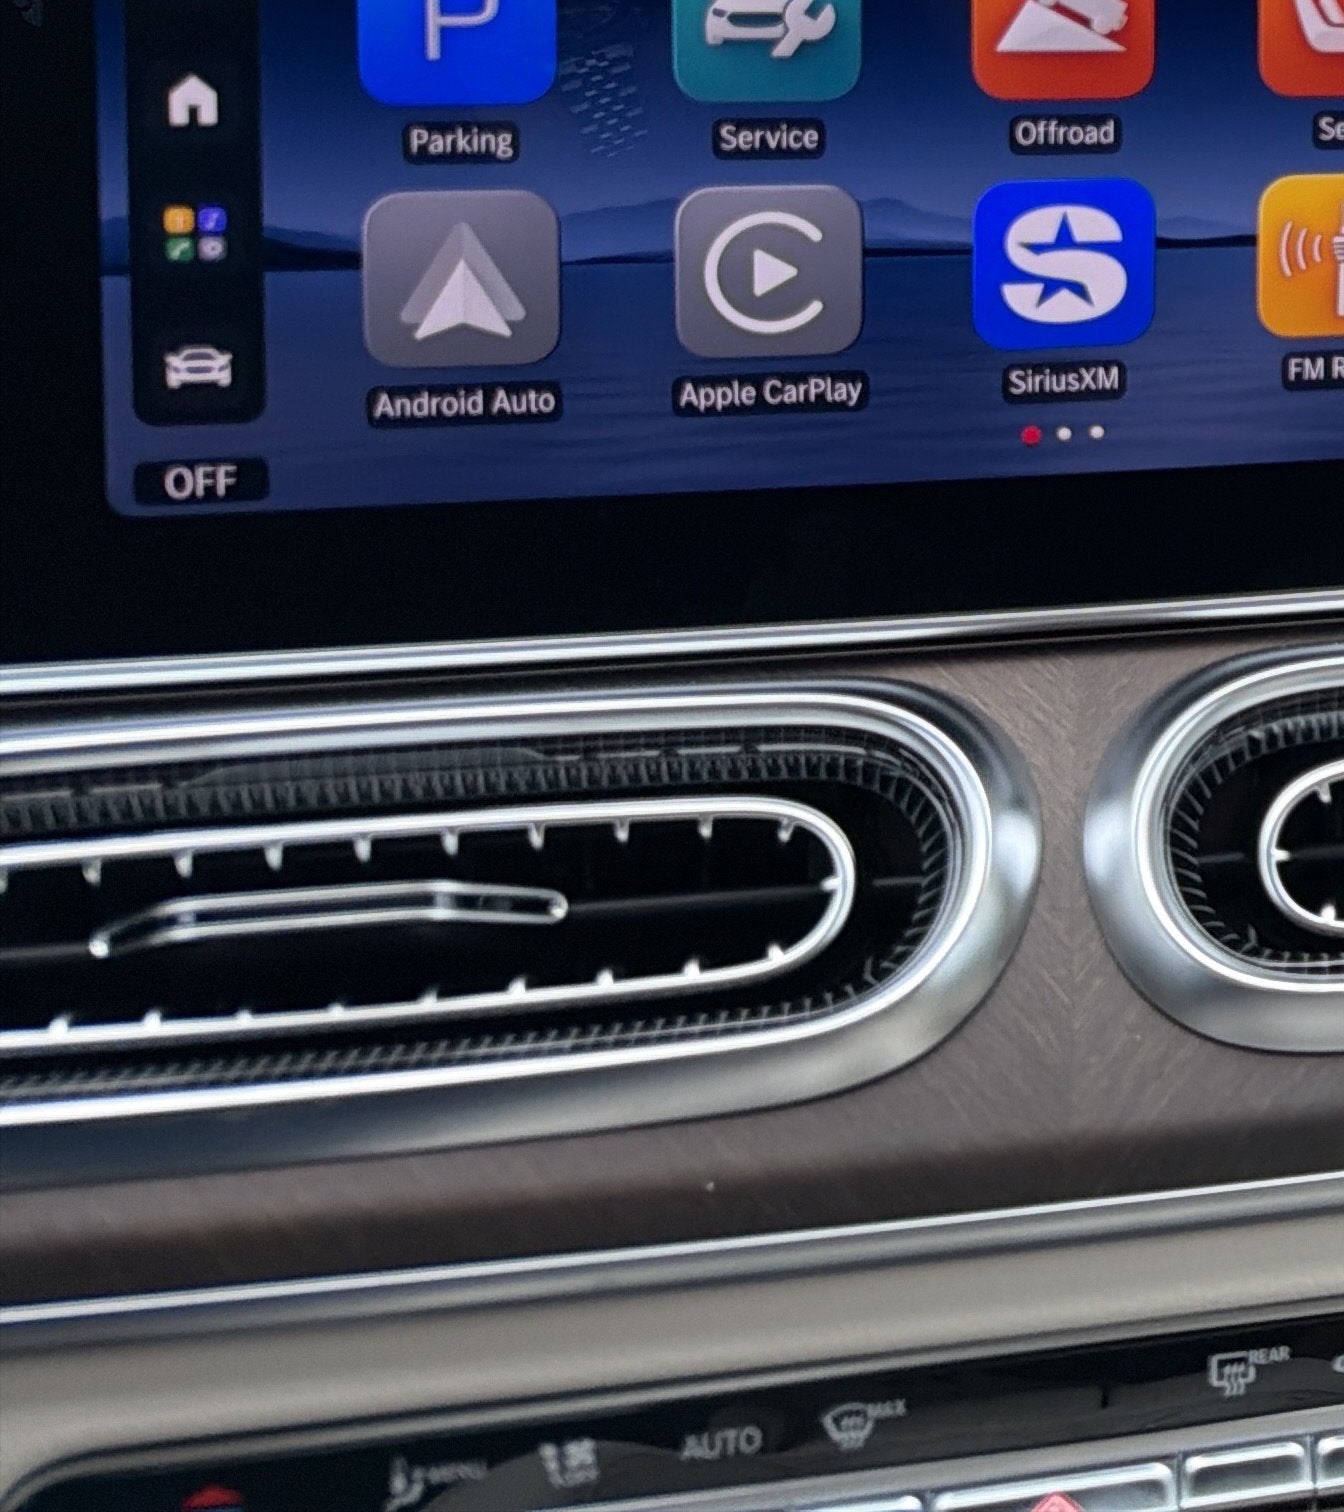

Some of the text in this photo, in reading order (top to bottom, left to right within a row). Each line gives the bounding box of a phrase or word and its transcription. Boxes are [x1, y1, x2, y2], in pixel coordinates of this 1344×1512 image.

[410, 127, 514, 160] Parking
[719, 123, 819, 152] Service
[1015, 117, 1115, 147] Offroad
[1009, 365, 1120, 397] SiriusXM
[1288, 357, 1325, 382] FM
[374, 387, 556, 419] Android Auto
[679, 375, 863, 411] Apple CarPlay
[164, 464, 238, 500] OFF
[1249, 1345, 1291, 1365] REAR
[679, 1425, 764, 1461] AUTO
